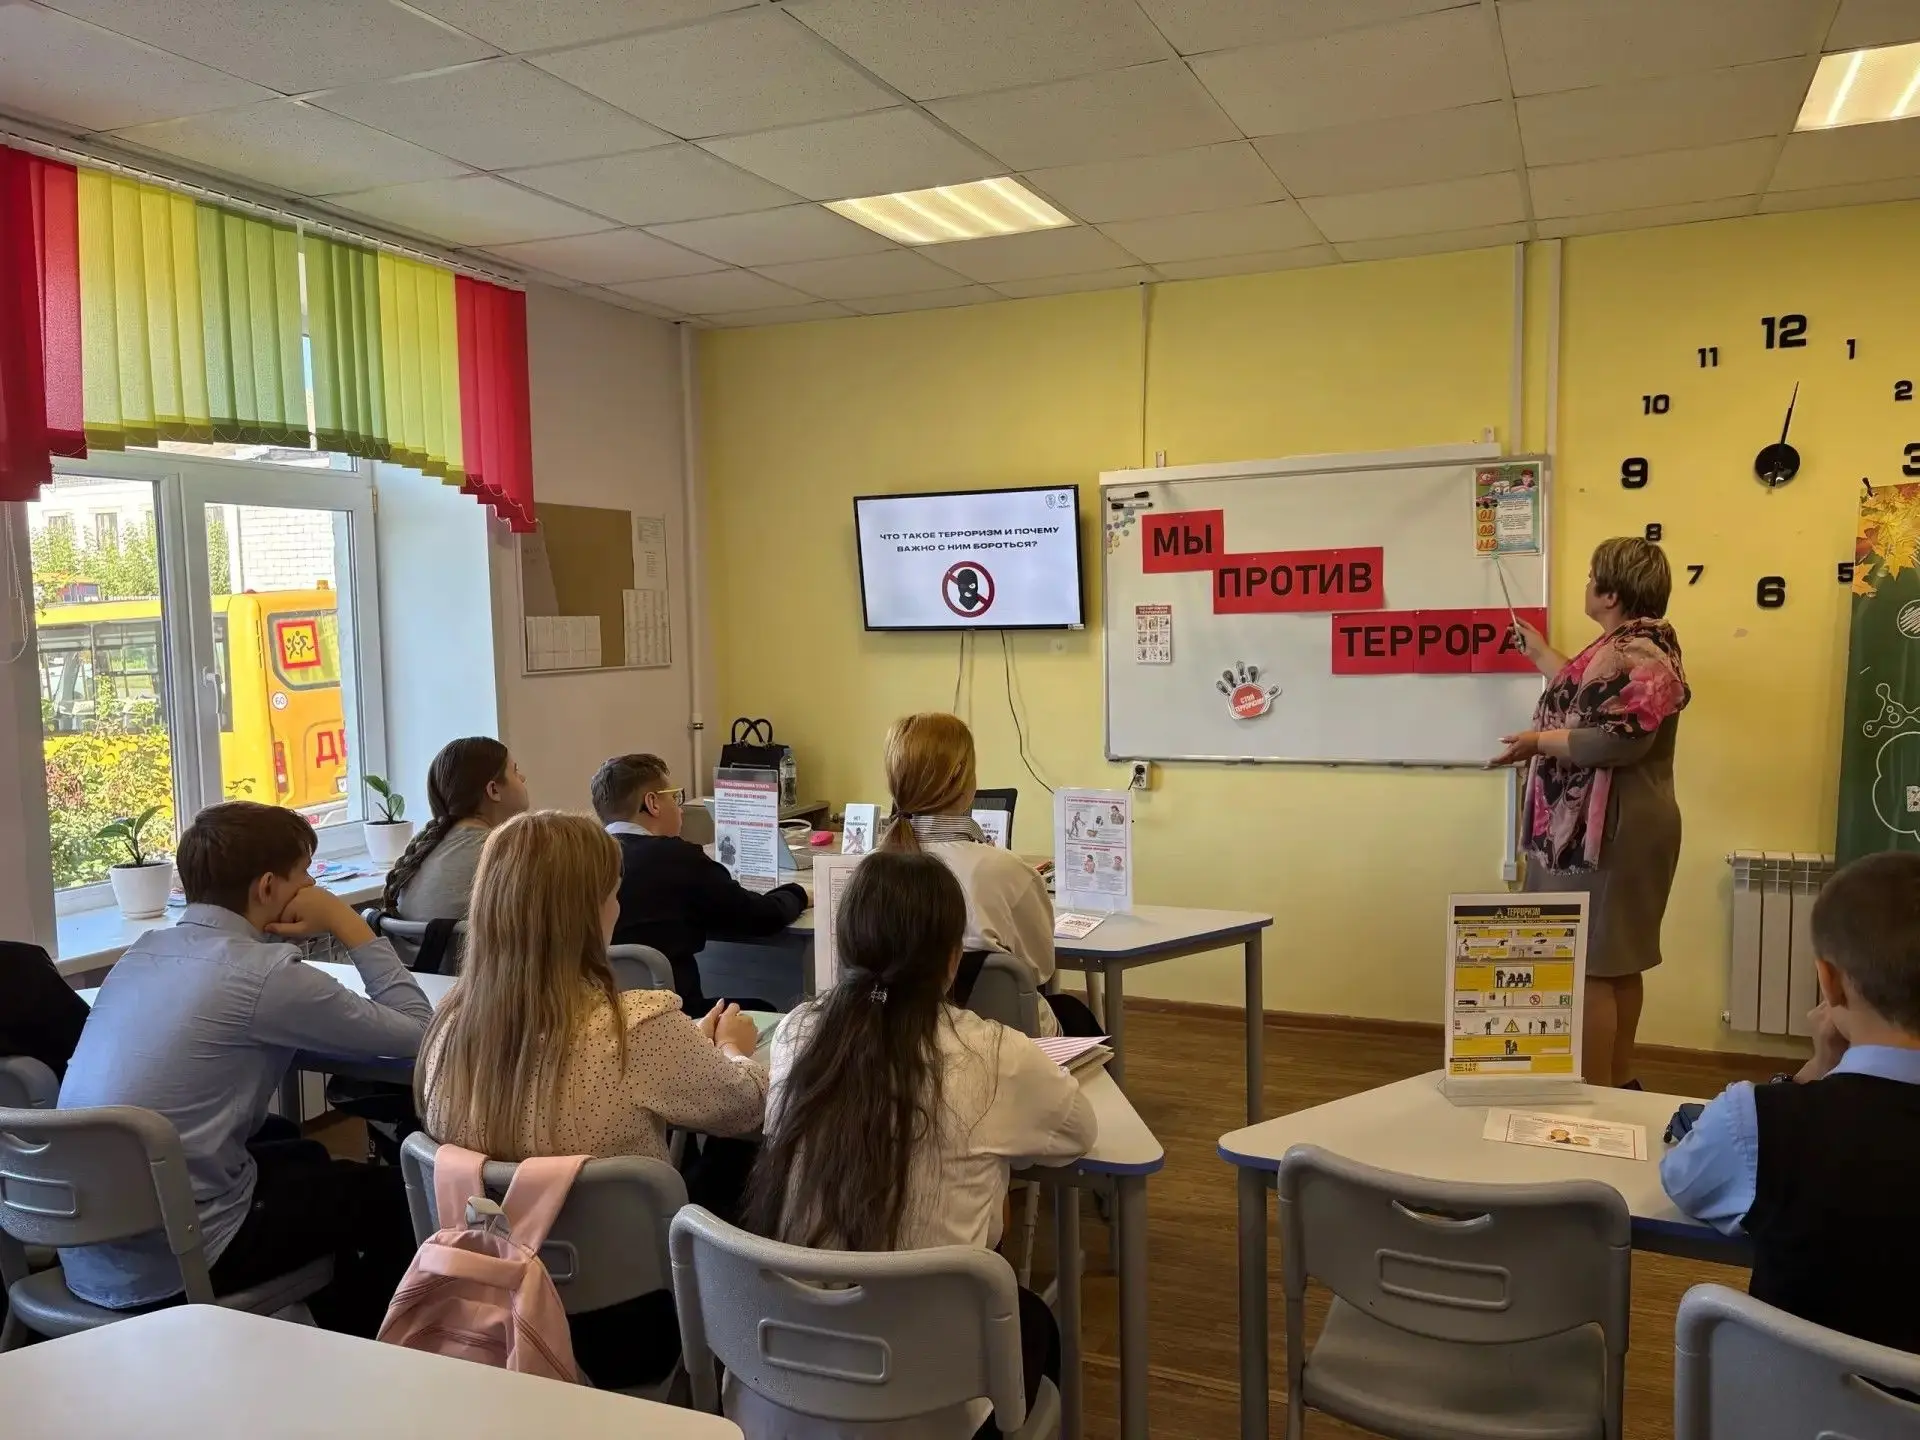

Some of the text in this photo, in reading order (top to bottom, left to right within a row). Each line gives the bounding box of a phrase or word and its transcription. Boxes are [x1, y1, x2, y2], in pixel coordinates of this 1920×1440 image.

[1761, 314, 1807, 349] 12
[1697, 347, 1718, 368] 11
[1846, 338, 1856, 360] 1
[1894, 380, 1913, 401] 2
[1642, 394, 1670, 415] 10
[1621, 457, 1649, 489] 9
[902, 532, 936, 540] ТАКОЕ
[938, 529, 1003, 538] ТЕРРОРИЗМ
[1014, 526, 1059, 535] ПОЧЕМУ
[1153, 524, 1212, 557] МЫ
[1645, 523, 1662, 541] 8
[947, 543, 971, 551] НИМ
[973, 541, 1038, 550] БОРОТЬСЯ?
[1218, 562, 1373, 598] ПРОТИВ
[1687, 565, 1704, 585] 7
[1837, 563, 1854, 583] 5
[1757, 576, 1785, 608] 6
